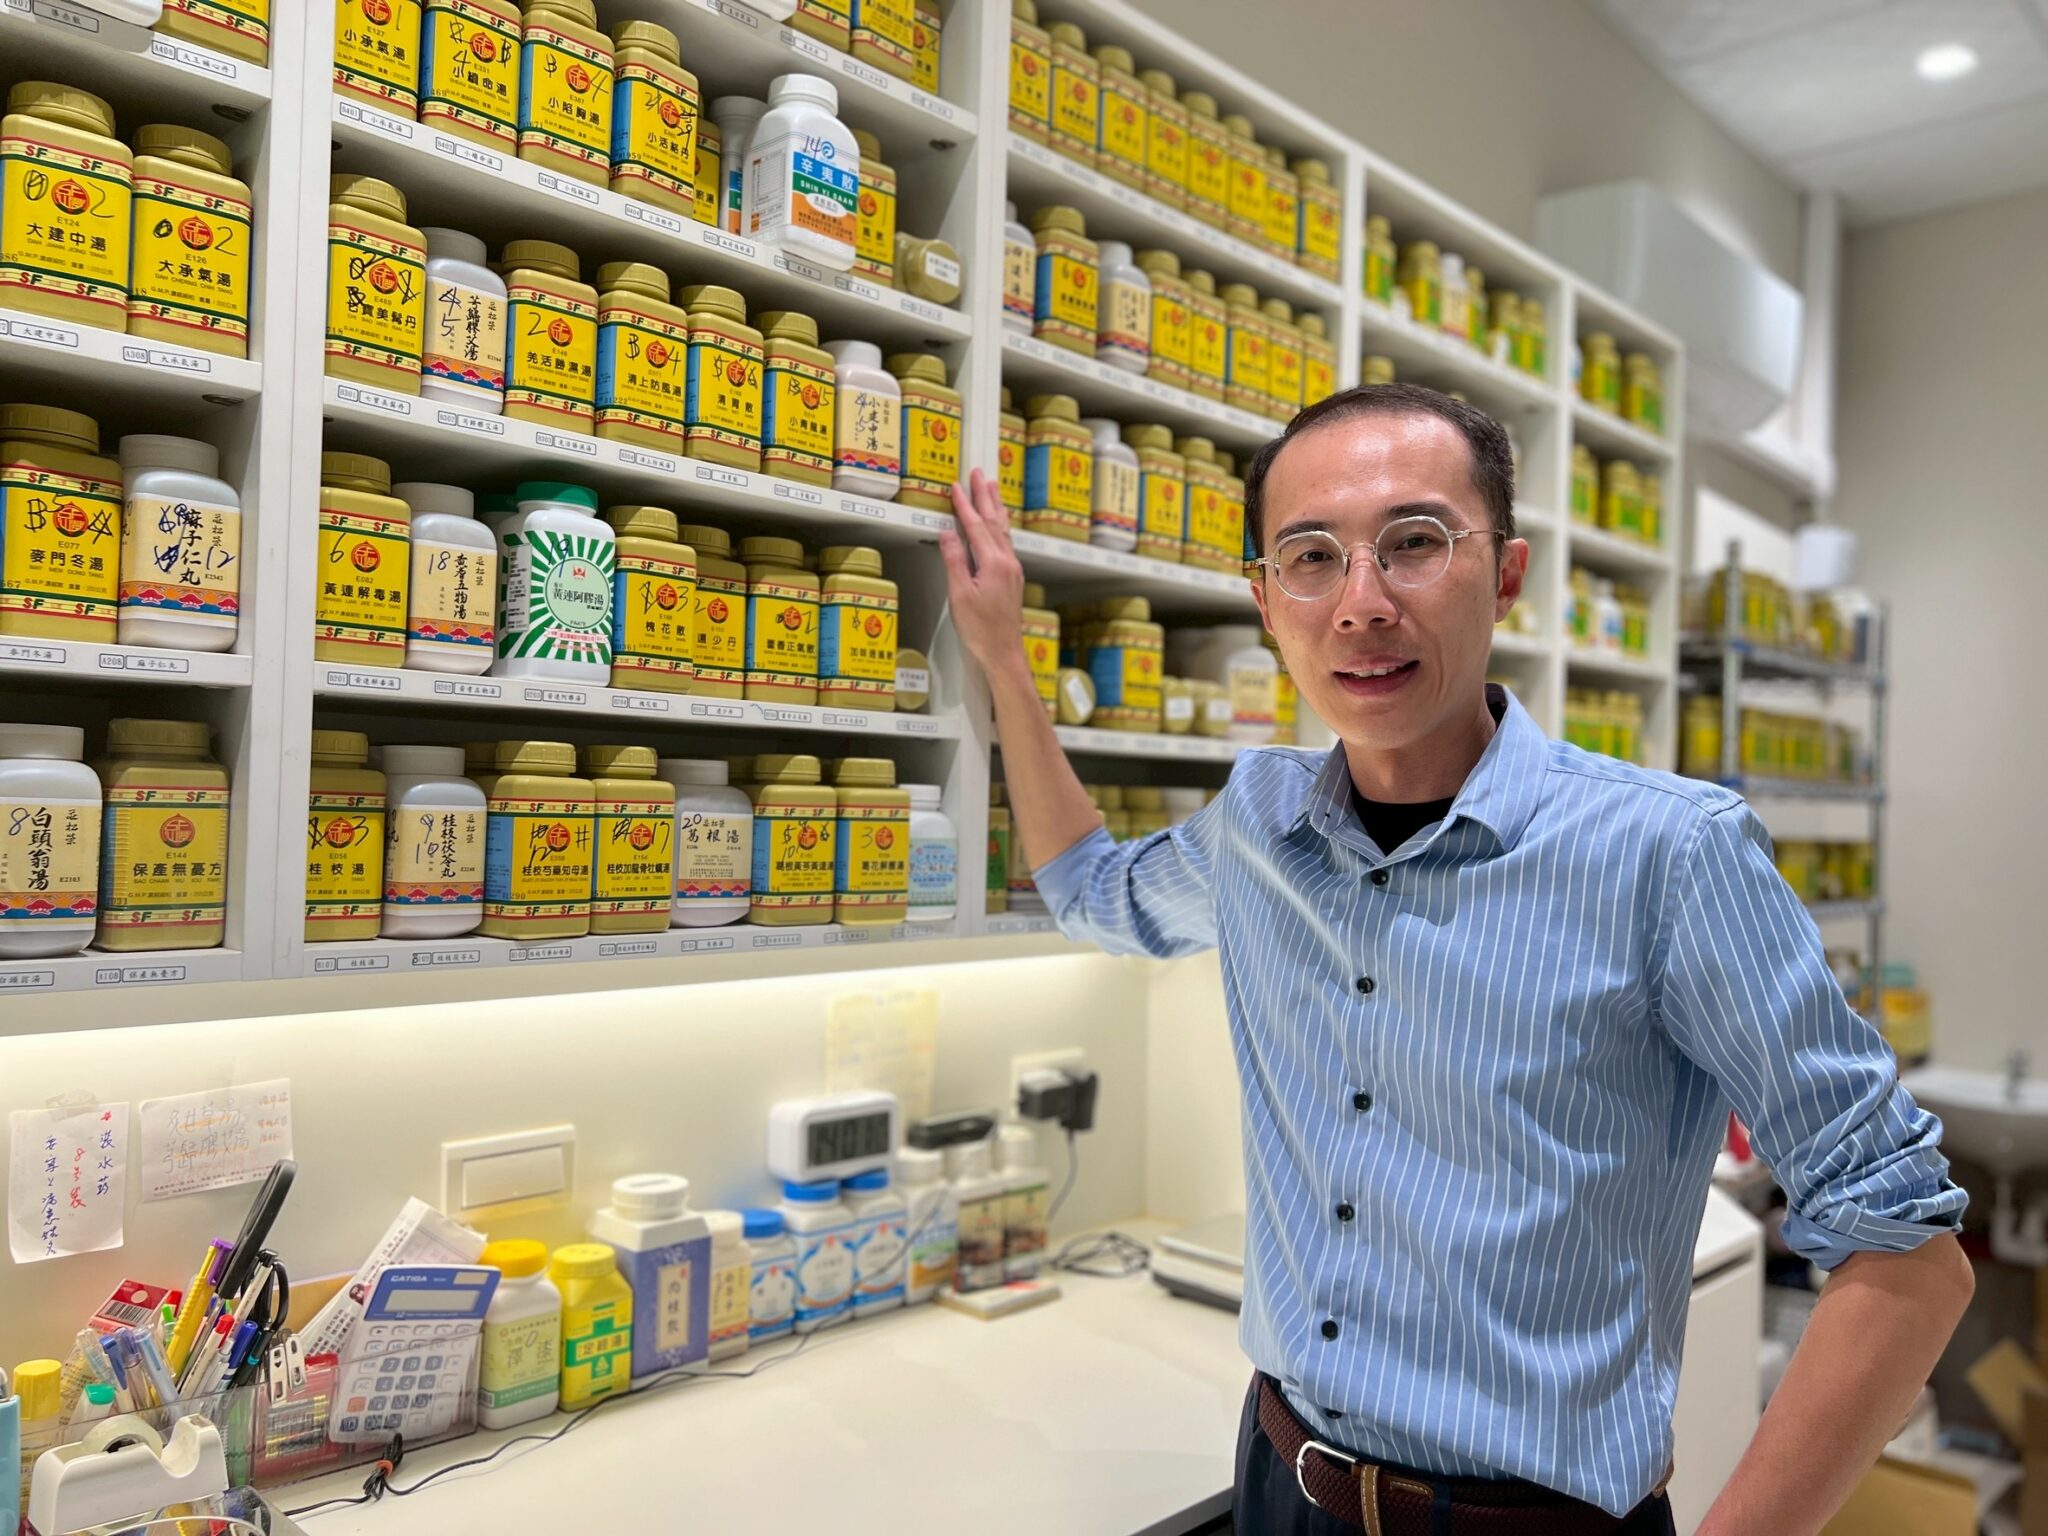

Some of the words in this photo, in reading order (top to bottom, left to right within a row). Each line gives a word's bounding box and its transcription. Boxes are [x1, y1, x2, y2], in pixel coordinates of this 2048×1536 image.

[225, 15, 245, 28] SF
[452, 0, 467, 12] SF
[490, 16, 505, 29] SF
[344, 28, 406, 61] 小承氣湯
[549, 34, 564, 45] SF
[585, 49, 599, 59] SF
[336, 70, 354, 82] SF
[379, 85, 396, 98] SF
[453, 67, 507, 96] 小續命湯
[646, 71, 657, 82] SF
[675, 86, 687, 96] SF
[549, 97, 600, 125] 小陷胸湯
[648, 132, 689, 159] 小活絡丹
[25, 145, 47, 157] SF
[81, 158, 103, 171] SF
[801, 158, 854, 191] 辛夷散
[153, 184, 174, 196] SF
[204, 197, 224, 209] SF
[800, 180, 818, 192] SHIN
[833, 193, 853, 206] SAAN
[57, 216, 79, 228] E124
[27, 223, 107, 252] 大建中湯
[348, 232, 366, 243] SF
[391, 245, 407, 256] SF
[19, 271, 42, 284] SF
[76, 283, 98, 295] SF
[159, 260, 231, 287] 大承氣湯
[531, 292, 546, 302] SF
[566, 302, 580, 313] SF
[631, 314, 644, 324] SF
[662, 325, 675, 335] SF
[713, 336, 725, 345] SF
[742, 345, 752, 354] SF
[627, 373, 681, 397] 清上防風湯
[718, 394, 754, 414] 清胃散
[790, 416, 827, 435] 小青龍湯
[867, 398, 880, 451] 小建中湯
[27, 472, 50, 484] SF
[79, 480, 100, 493] SF
[330, 515, 348, 526] SF
[373, 522, 389, 533] SF
[58, 541, 79, 550] E077
[179, 509, 203, 585] 麻子仁丸
[330, 533, 346, 563] 6
[30, 549, 104, 572] 麥門冬湯
[428, 551, 450, 575] 18
[324, 582, 401, 603] 黃連解毒湯
[553, 589, 604, 606] 黃連阿膠湯
[23, 597, 44, 609] SF
[75, 603, 95, 615] SF
[325, 627, 343, 638] SF
[368, 631, 385, 642] SF
[646, 622, 685, 636] 槐花散
[135, 790, 156, 802] SF
[186, 792, 206, 802] SF
[682, 813, 702, 829] 20
[28, 807, 53, 890] 白頭翁湯
[440, 813, 457, 879] 桂枝茯苓丸
[132, 863, 222, 877] 保產無憂方
[309, 863, 365, 875] 桂枝湯
[130, 911, 152, 922] SF
[182, 910, 201, 920] SF
